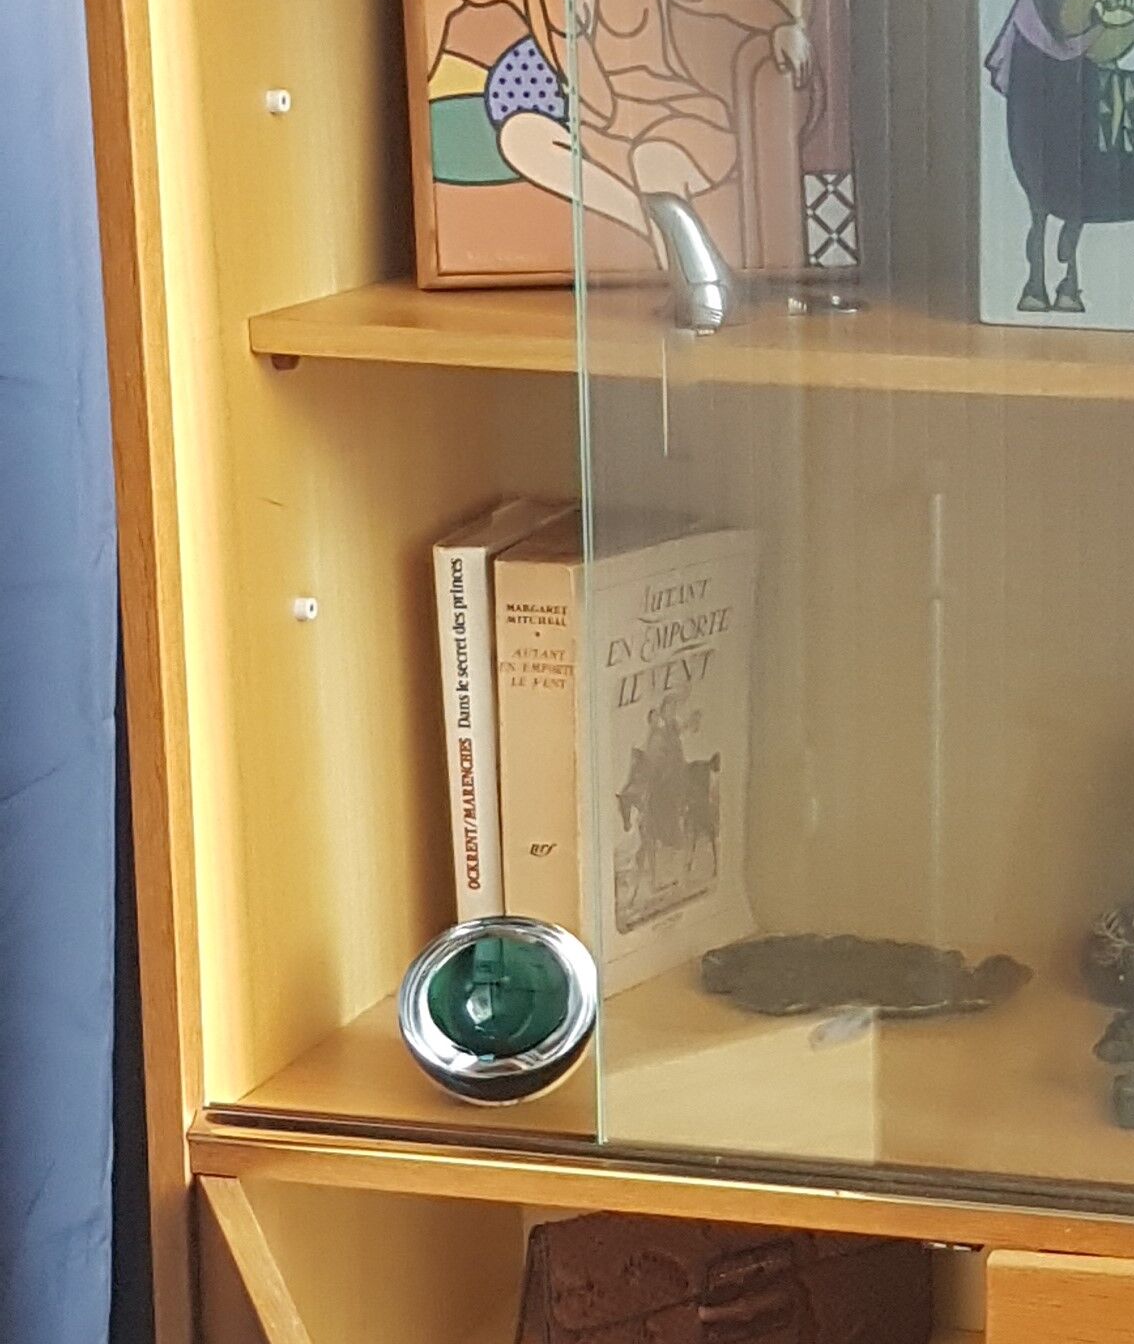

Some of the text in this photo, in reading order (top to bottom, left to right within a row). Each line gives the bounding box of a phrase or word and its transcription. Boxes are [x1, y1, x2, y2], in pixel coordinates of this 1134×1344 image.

[506, 603, 568, 615] MARGARET
[506, 615, 567, 627] MITCHELL
[512, 648, 567, 662] AUTANT
[447, 557, 481, 889] OCKRENT/MARENCHES Dans le secret des princes
